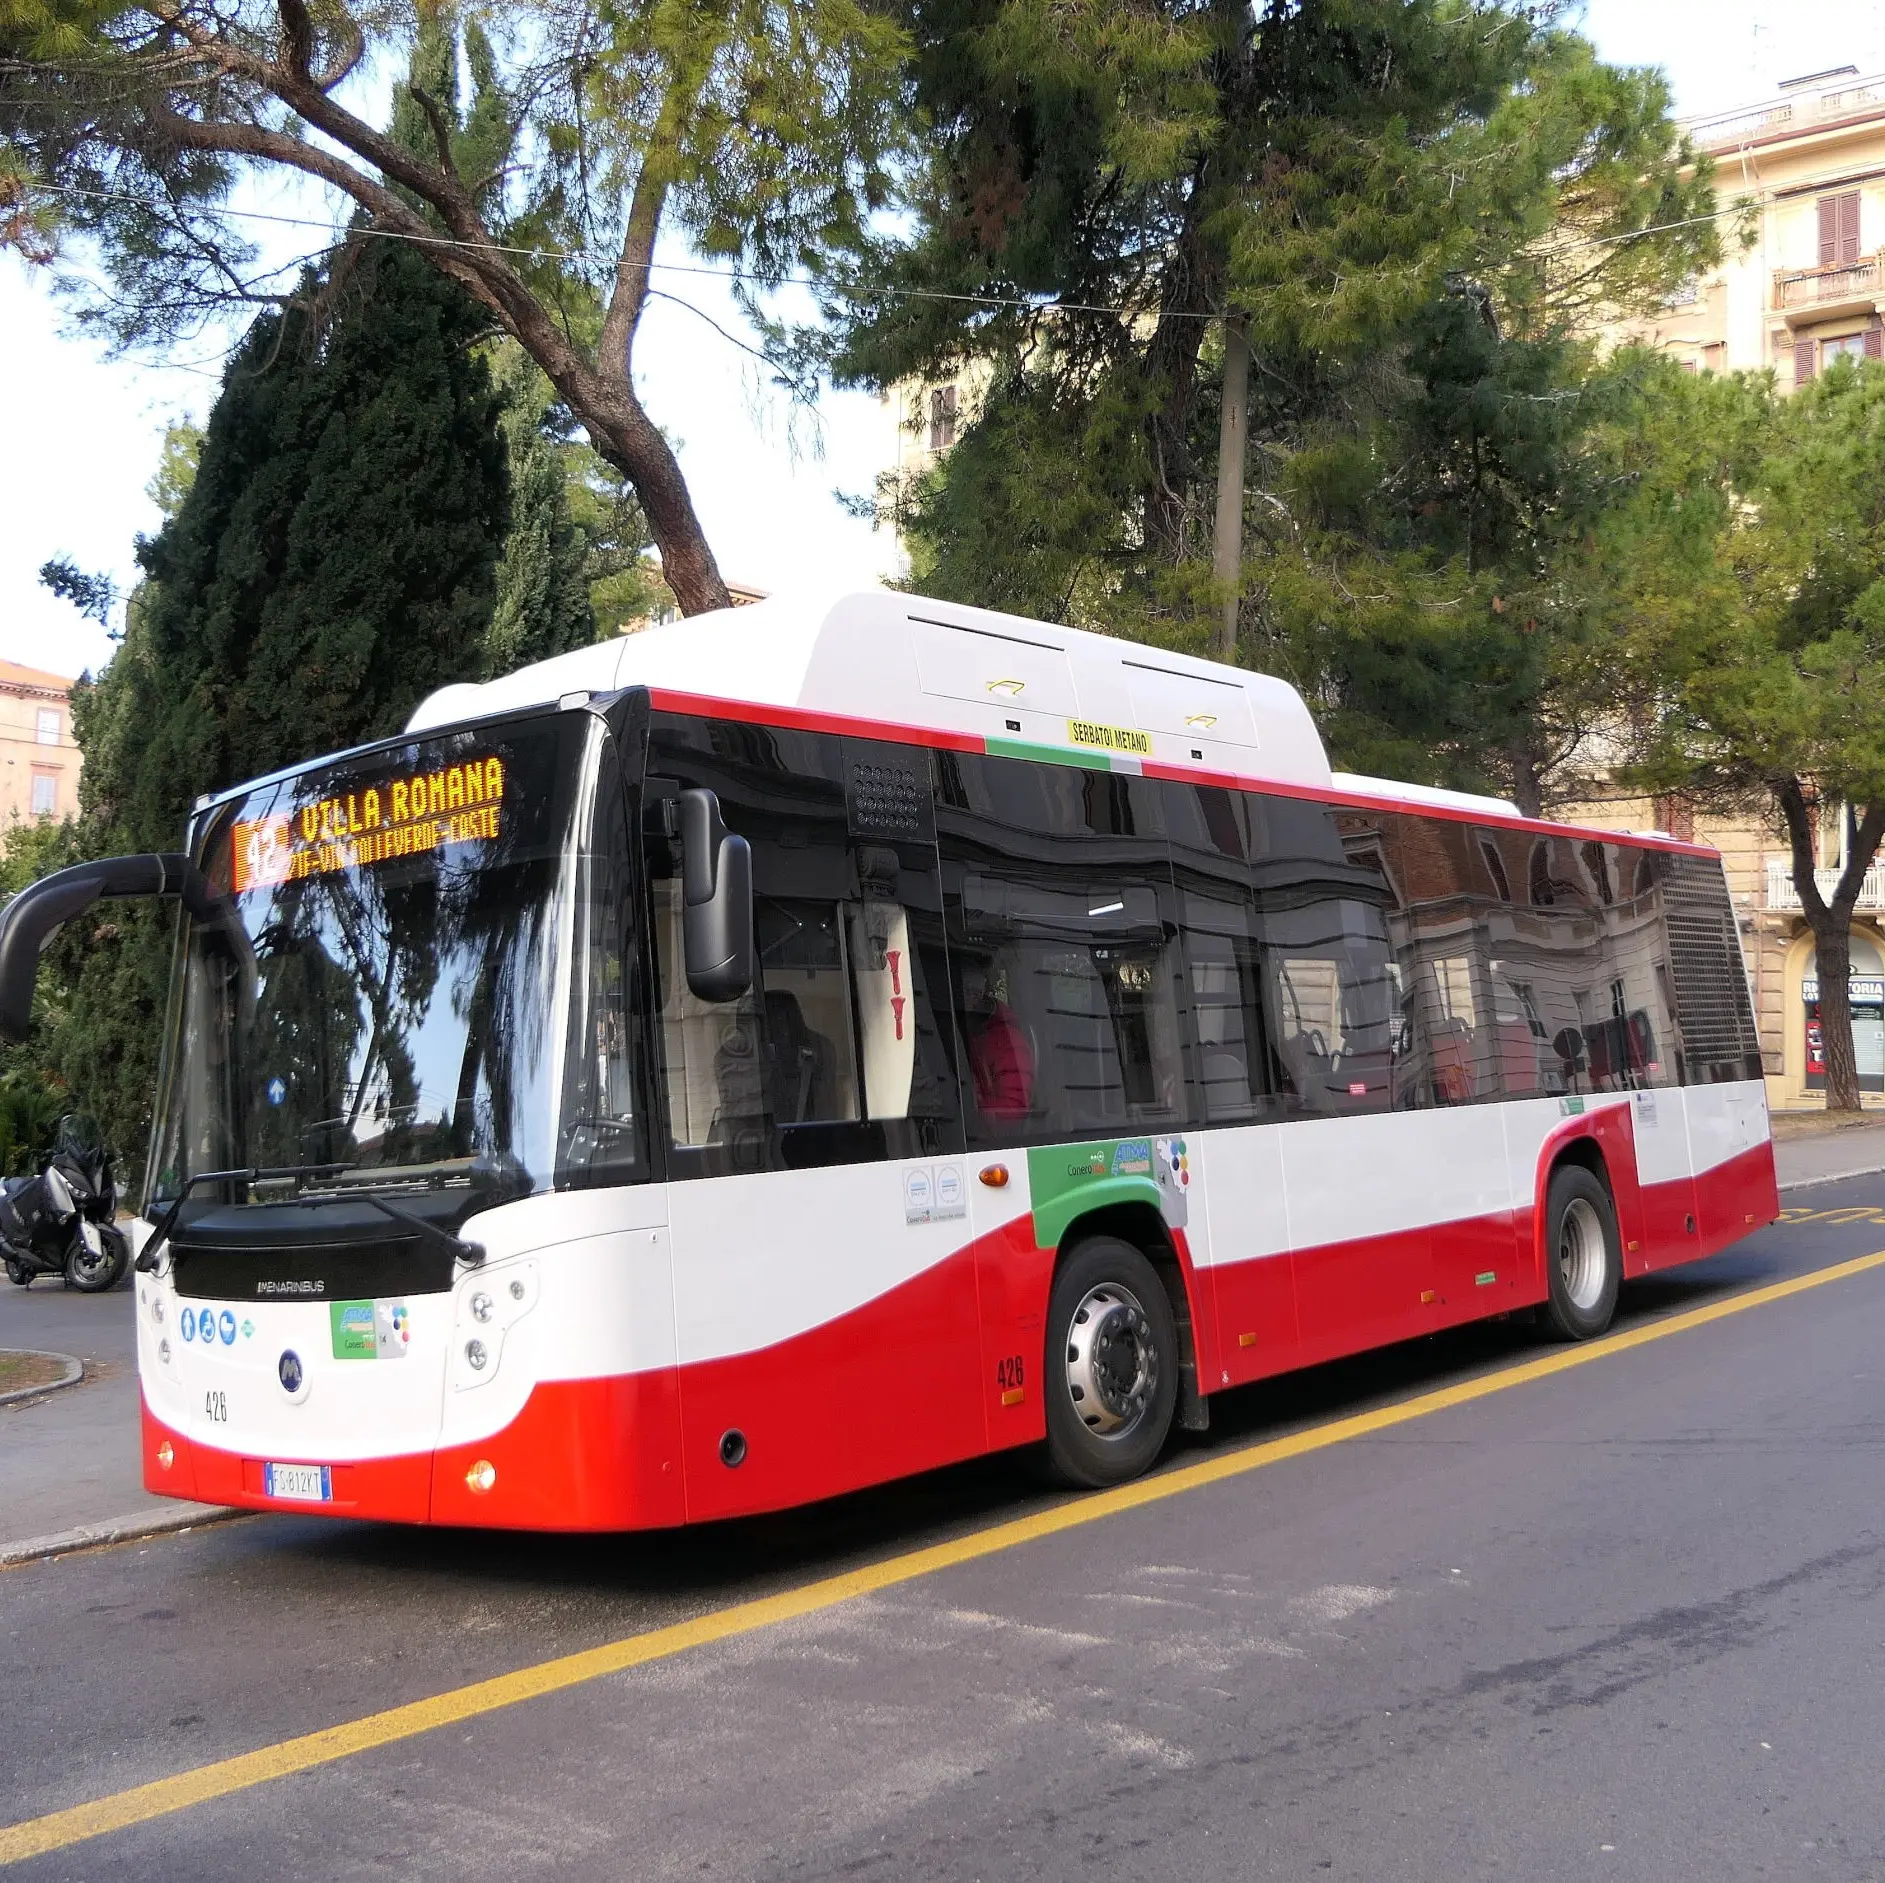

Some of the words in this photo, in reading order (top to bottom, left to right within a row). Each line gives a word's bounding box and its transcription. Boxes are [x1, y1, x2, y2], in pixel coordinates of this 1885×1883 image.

[1072, 722, 1113, 747] SERBATOI
[1114, 729, 1147, 752] METANO
[302, 788, 381, 843] VILLA
[390, 756, 504, 824] ROMANA
[997, 1355, 1024, 1390] 426
[206, 1391, 227, 1422] 426
